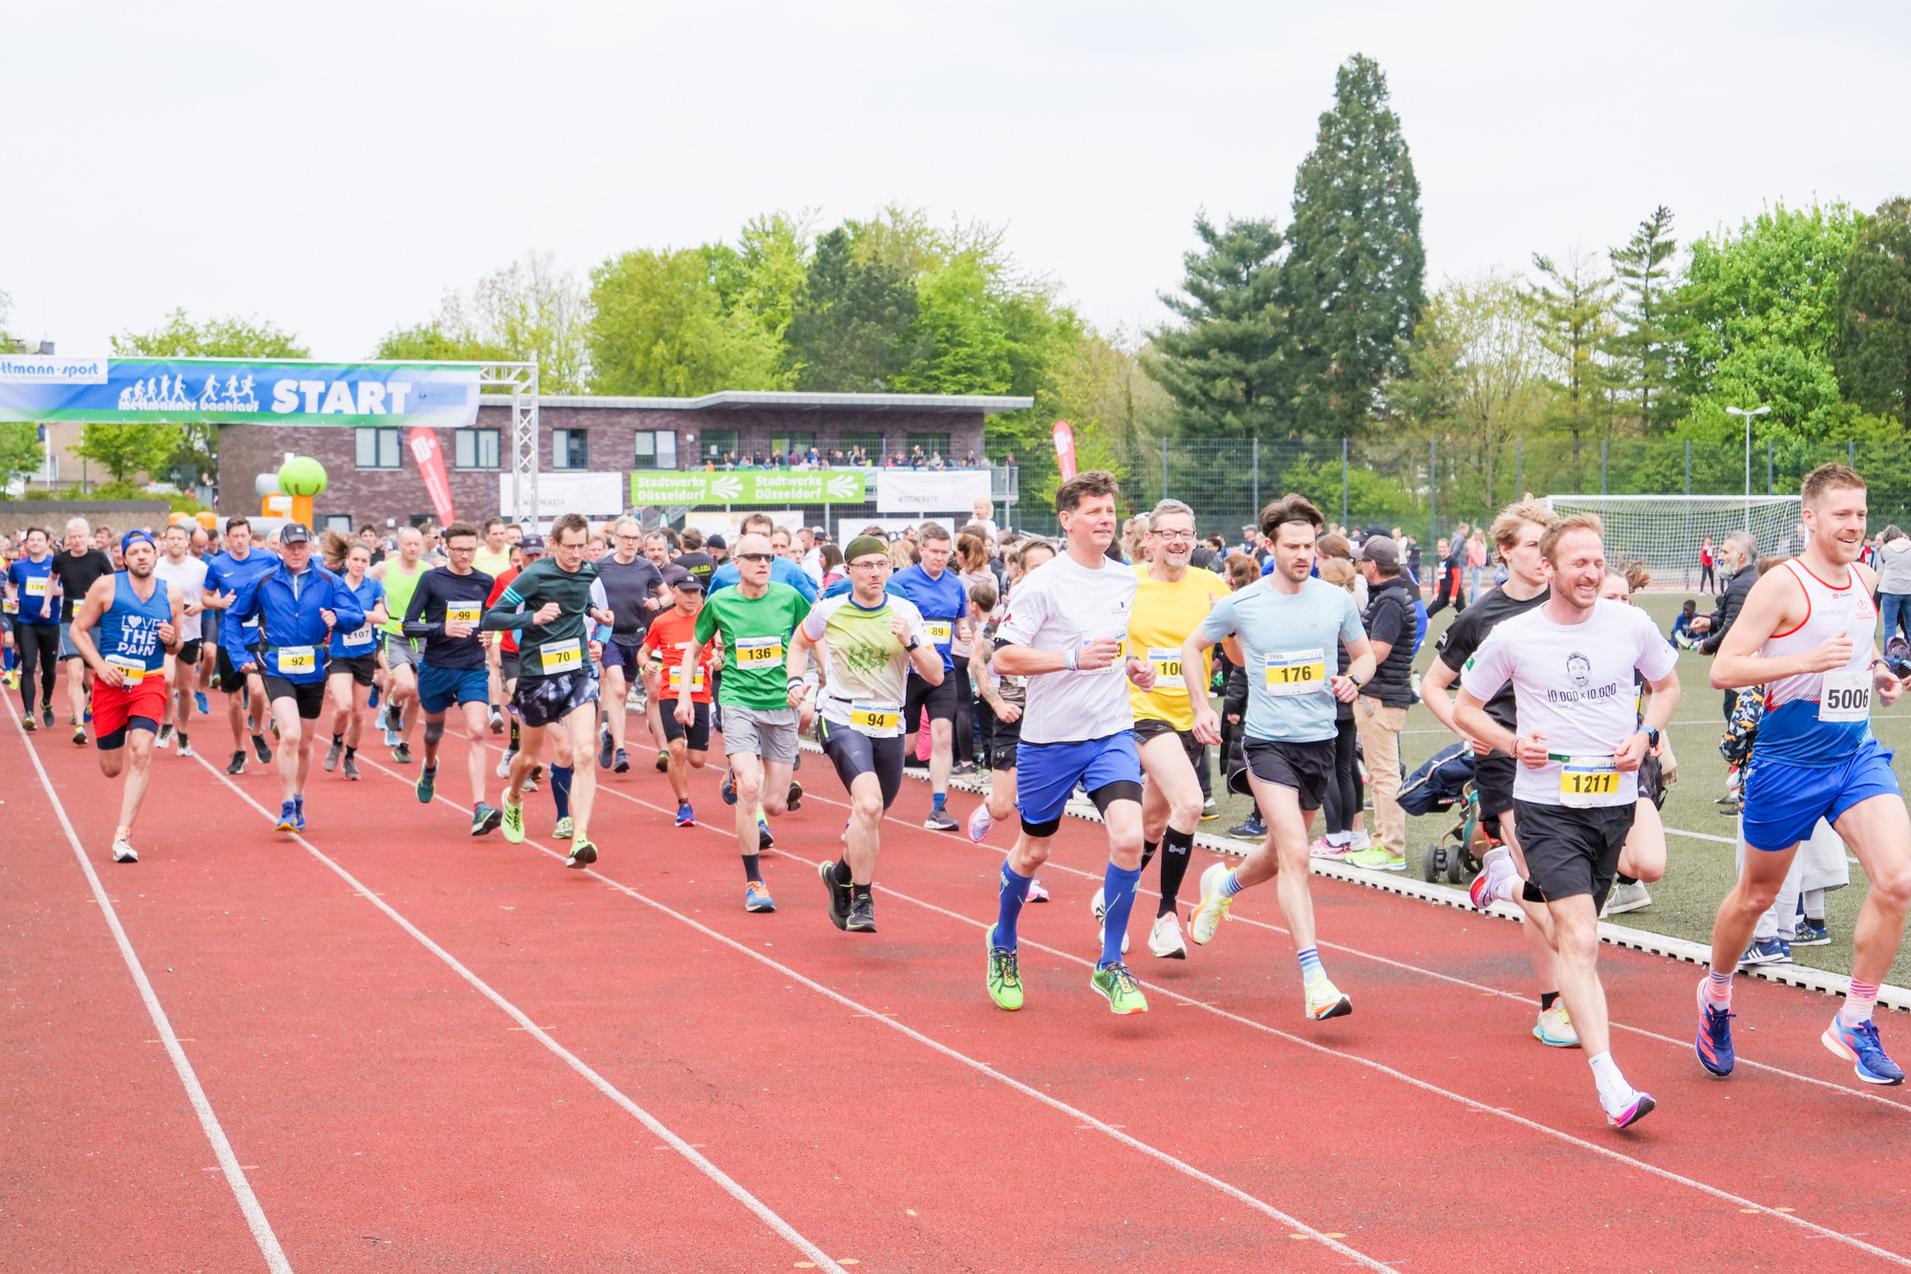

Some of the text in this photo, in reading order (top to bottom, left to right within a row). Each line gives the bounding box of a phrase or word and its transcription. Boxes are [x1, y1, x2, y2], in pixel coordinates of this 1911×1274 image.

[0, 362, 98, 378] ttmann-sport
[271, 379, 412, 414] START
[638, 475, 706, 487] Stadtwerke
[755, 475, 823, 487] Stadtwerke
[638, 488, 706, 501] Düsseldorf
[755, 487, 822, 499] Düsseldorf
[458, 610, 470, 620] 99
[121, 627, 157, 645] THE
[932, 627, 944, 637] 89
[117, 642, 156, 656] PAIN
[748, 647, 771, 660] 136
[292, 656, 304, 666] 92
[556, 651, 570, 663] 70
[1281, 666, 1312, 682] 176
[1587, 682, 1617, 700] 10.000
[1827, 689, 1869, 709] 5006
[867, 713, 885, 727] 94
[1572, 775, 1611, 793] 1211
